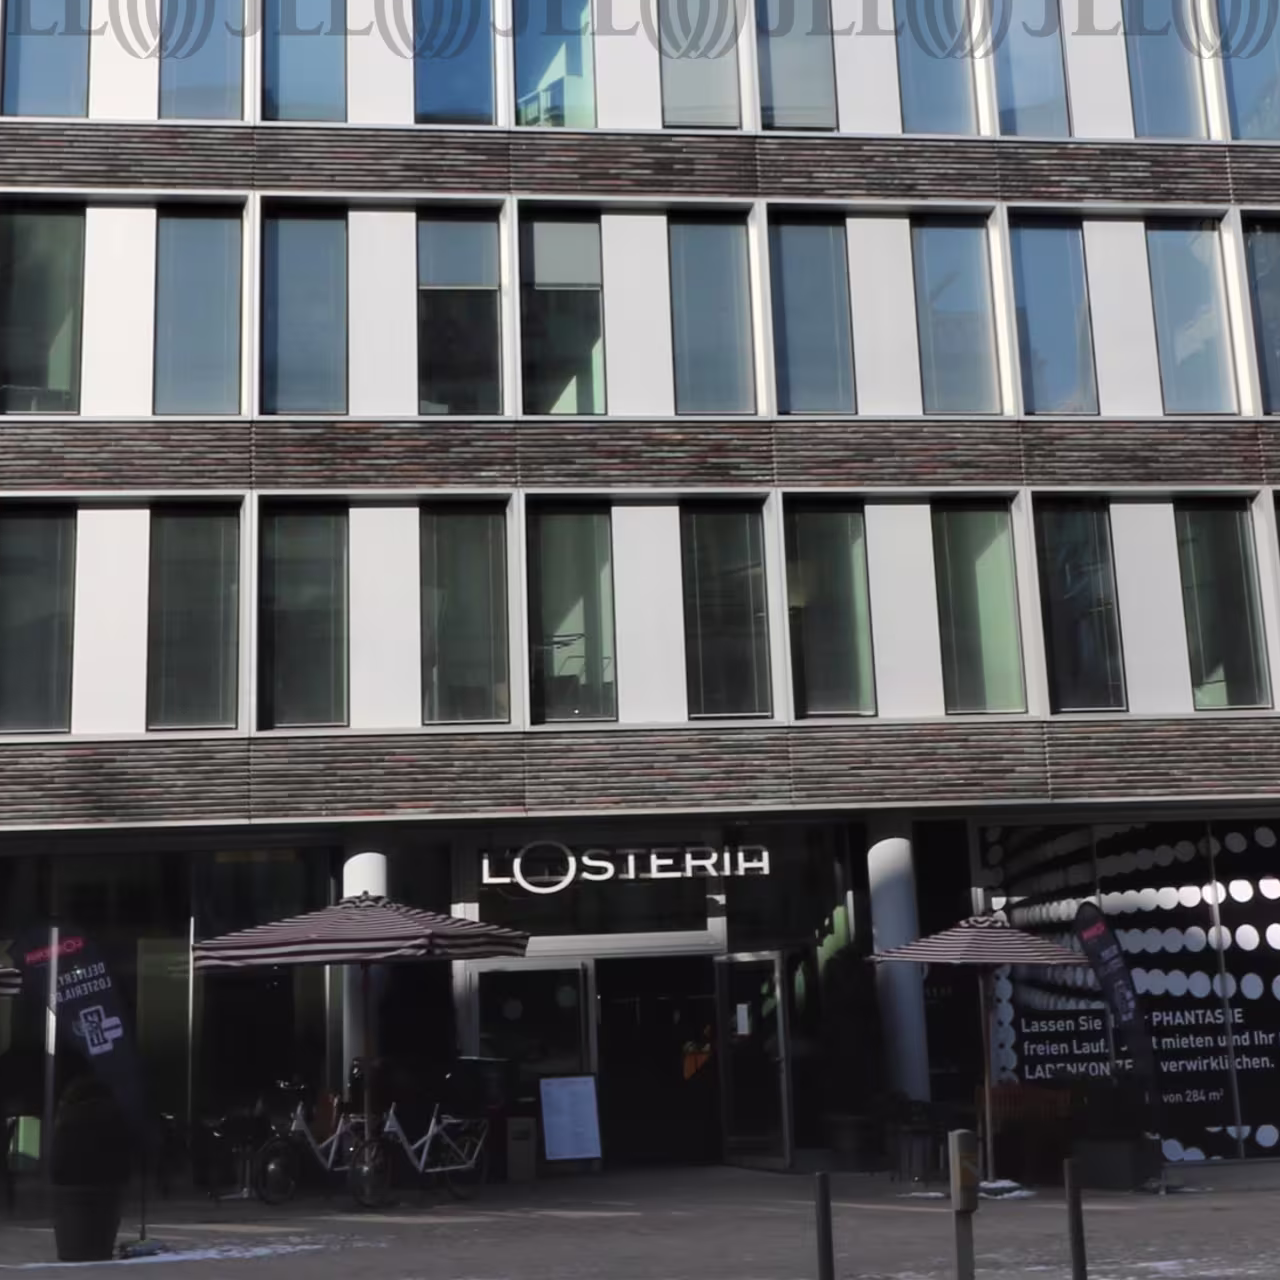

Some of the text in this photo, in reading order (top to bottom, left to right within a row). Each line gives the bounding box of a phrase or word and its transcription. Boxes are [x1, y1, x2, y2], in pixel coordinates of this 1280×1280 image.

[1021, 1017, 1075, 1033] Lassen
[1078, 1015, 1103, 1031] Sie
[1024, 1040, 1069, 1056] freien
[1073, 1038, 1110, 1054] Lauf.
[1161, 1033, 1213, 1050] mieten
[1217, 1031, 1251, 1047] und
[1254, 1029, 1275, 1045] Ihr
[1162, 1092, 1183, 1104] von
[1186, 1088, 1206, 1102] 284
